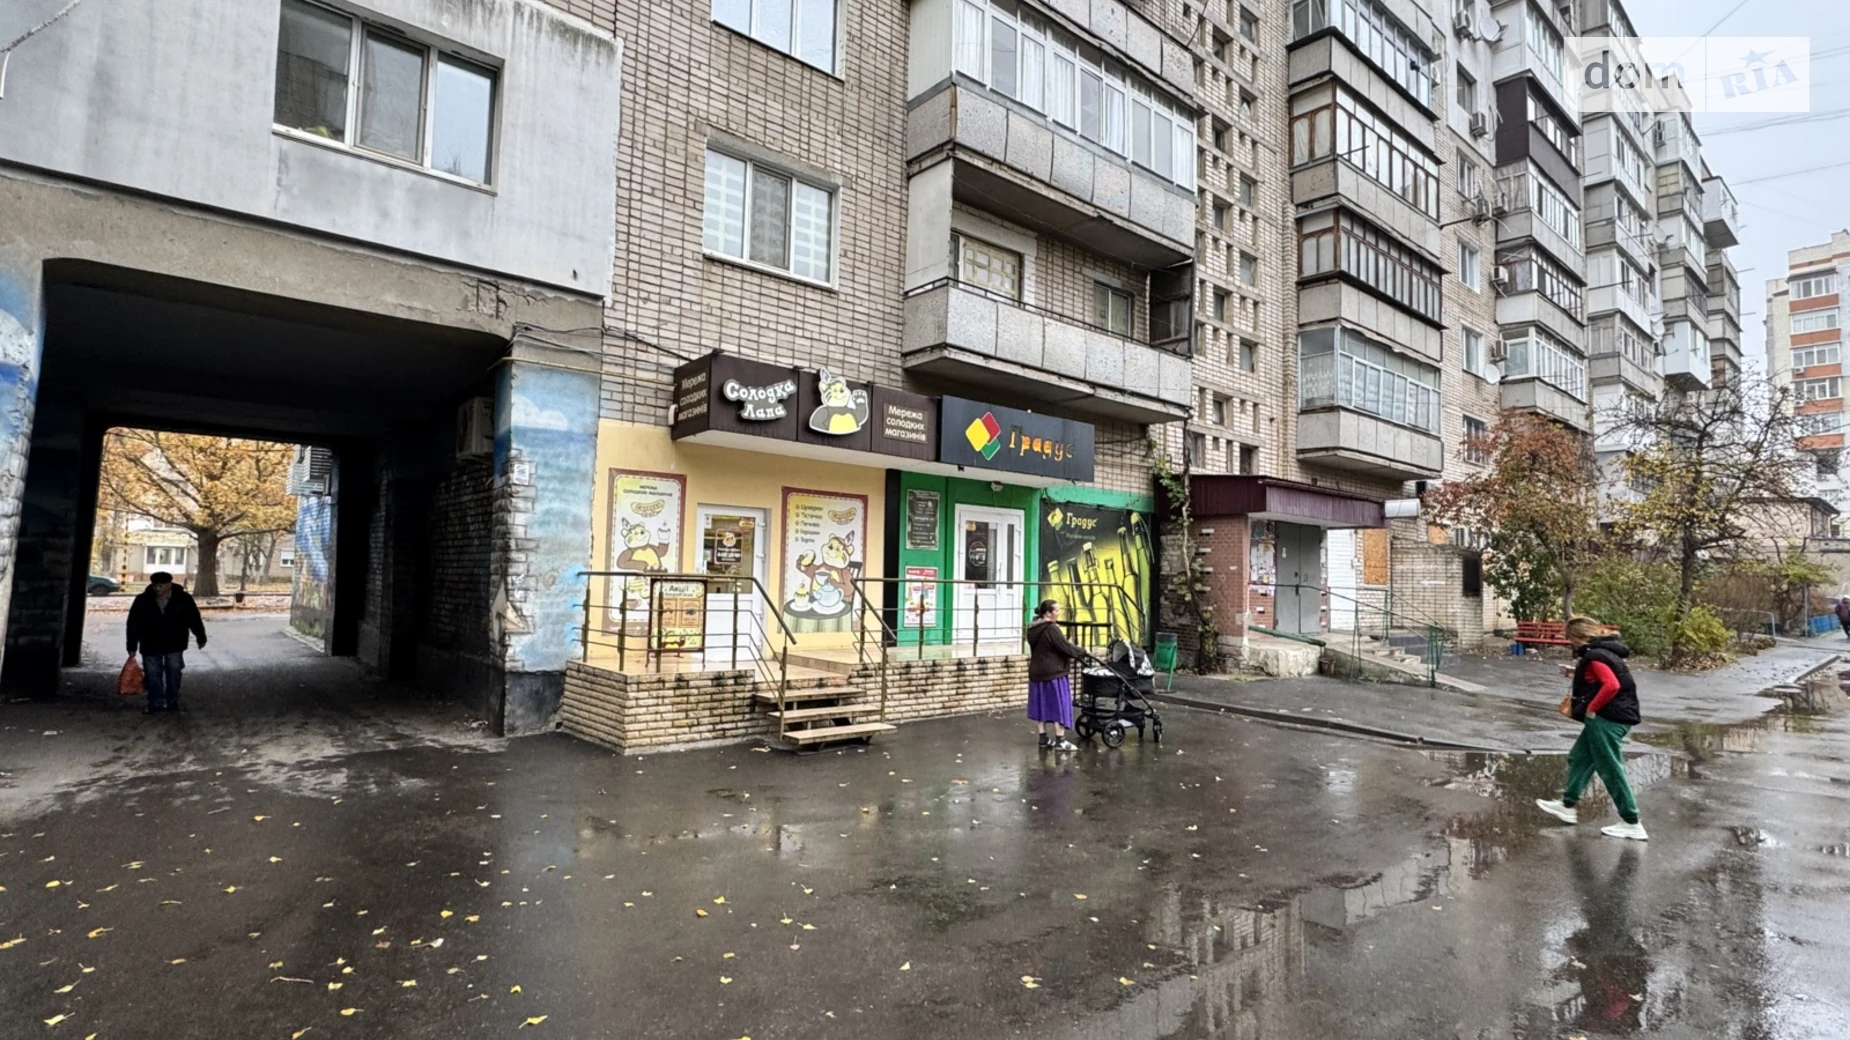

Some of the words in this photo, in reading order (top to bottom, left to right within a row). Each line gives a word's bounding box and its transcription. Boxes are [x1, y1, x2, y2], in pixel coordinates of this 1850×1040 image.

[681, 372, 706, 390] Мережа
[679, 388, 708, 406] солодких
[725, 381, 795, 403] Солодка
[678, 403, 708, 421] магазинів
[743, 404, 785, 418] Лапа
[888, 405, 923, 420] Мережа
[886, 418, 925, 431] солодких
[884, 427, 927, 442] магазинів
[1066, 512, 1097, 530] Градус
